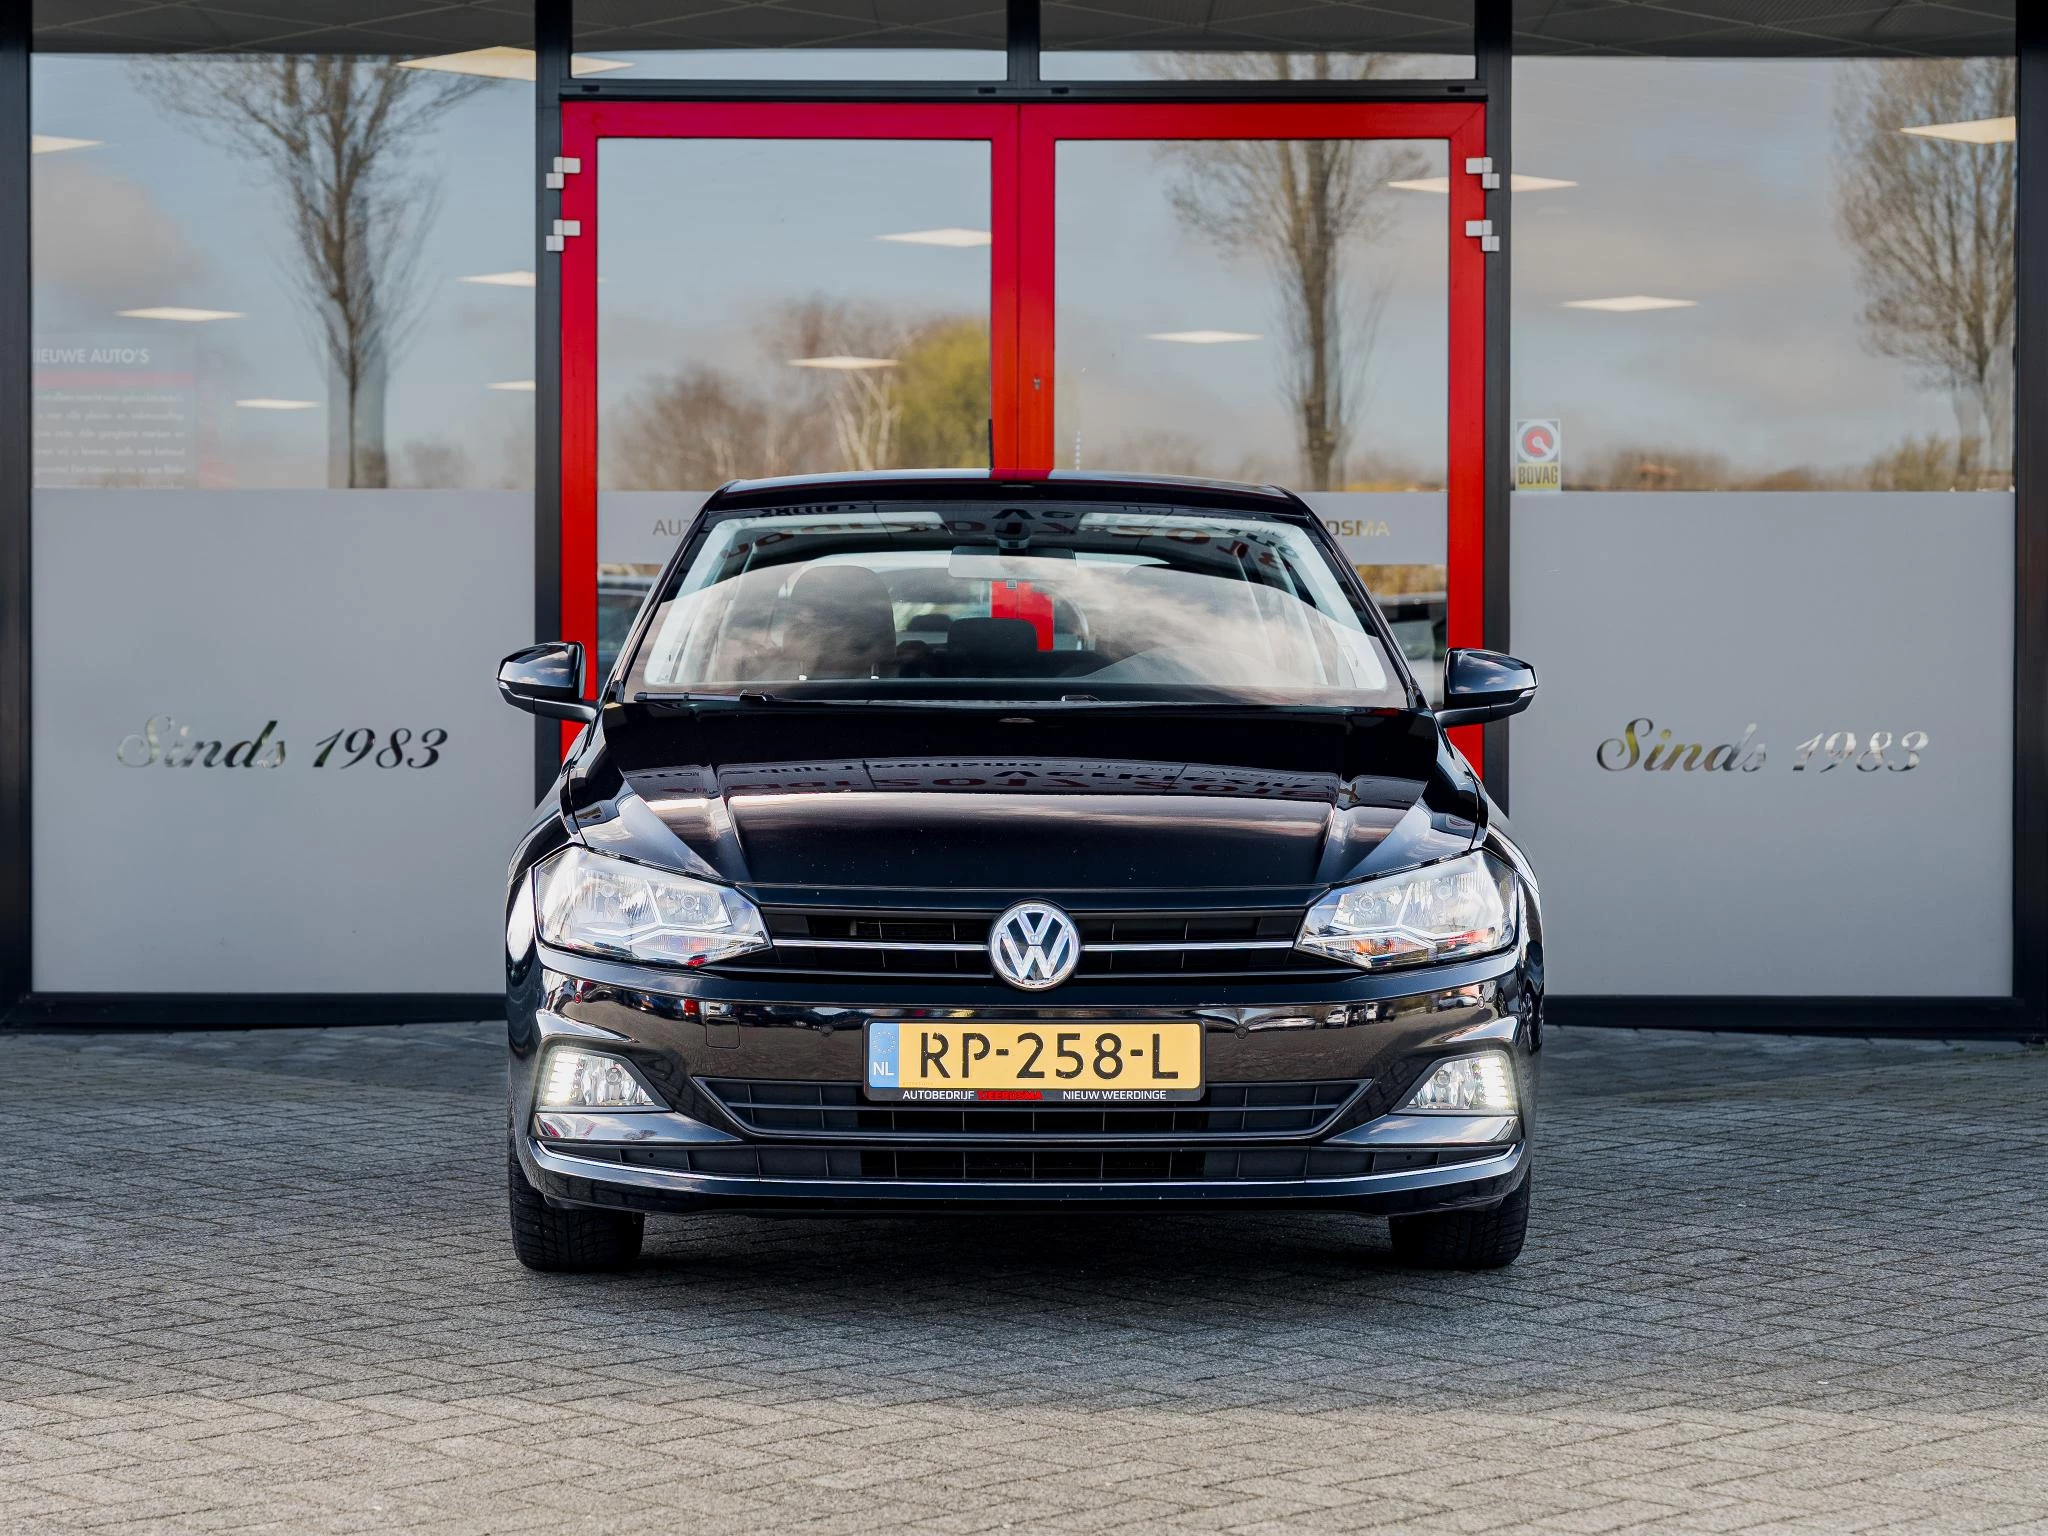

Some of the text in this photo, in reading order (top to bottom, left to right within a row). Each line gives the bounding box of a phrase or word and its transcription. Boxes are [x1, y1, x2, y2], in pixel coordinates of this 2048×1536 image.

[90, 348, 150, 364] AUTO'S
[1518, 465, 1558, 485] BOVAG
[116, 713, 449, 769] Sinds 1983
[1596, 717, 1930, 773] Sinds 1983
[920, 1031, 1180, 1080] RP-258-L
[873, 1061, 895, 1077] NL
[902, 1090, 975, 1100] AUTOBEDRIJF
[1062, 1090, 1100, 1100] NIEUW
[1101, 1090, 1167, 1100] WEERDINGE
